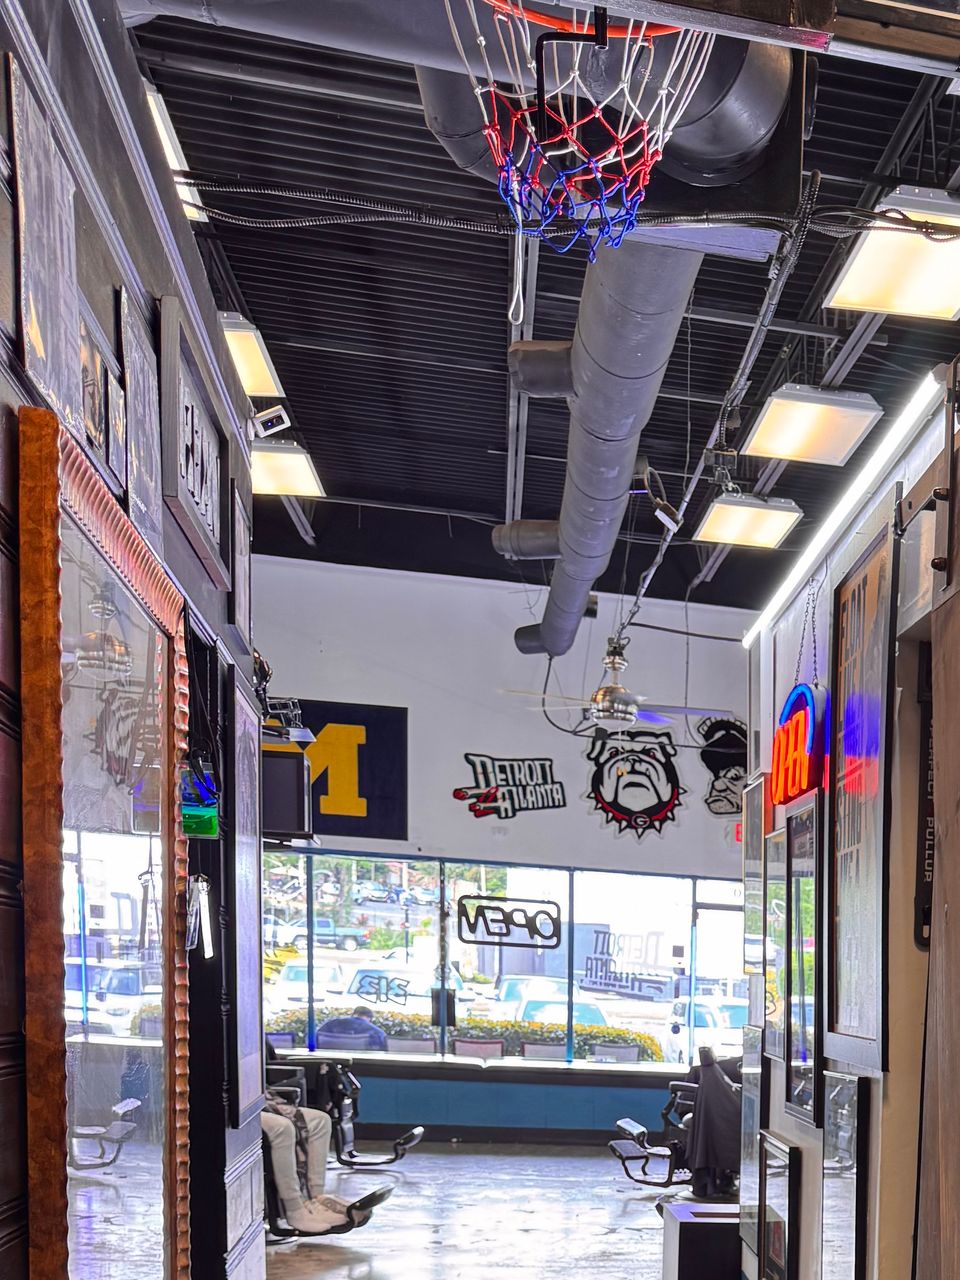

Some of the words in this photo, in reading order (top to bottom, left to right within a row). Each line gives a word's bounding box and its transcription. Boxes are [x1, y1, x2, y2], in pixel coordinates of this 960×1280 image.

[839, 575, 867, 667] FLOAT
[465, 753, 552, 789] DETROIT
[771, 707, 810, 804] OPEN
[497, 782, 566, 818] ATLANTA
[632, 814, 649, 828] G
